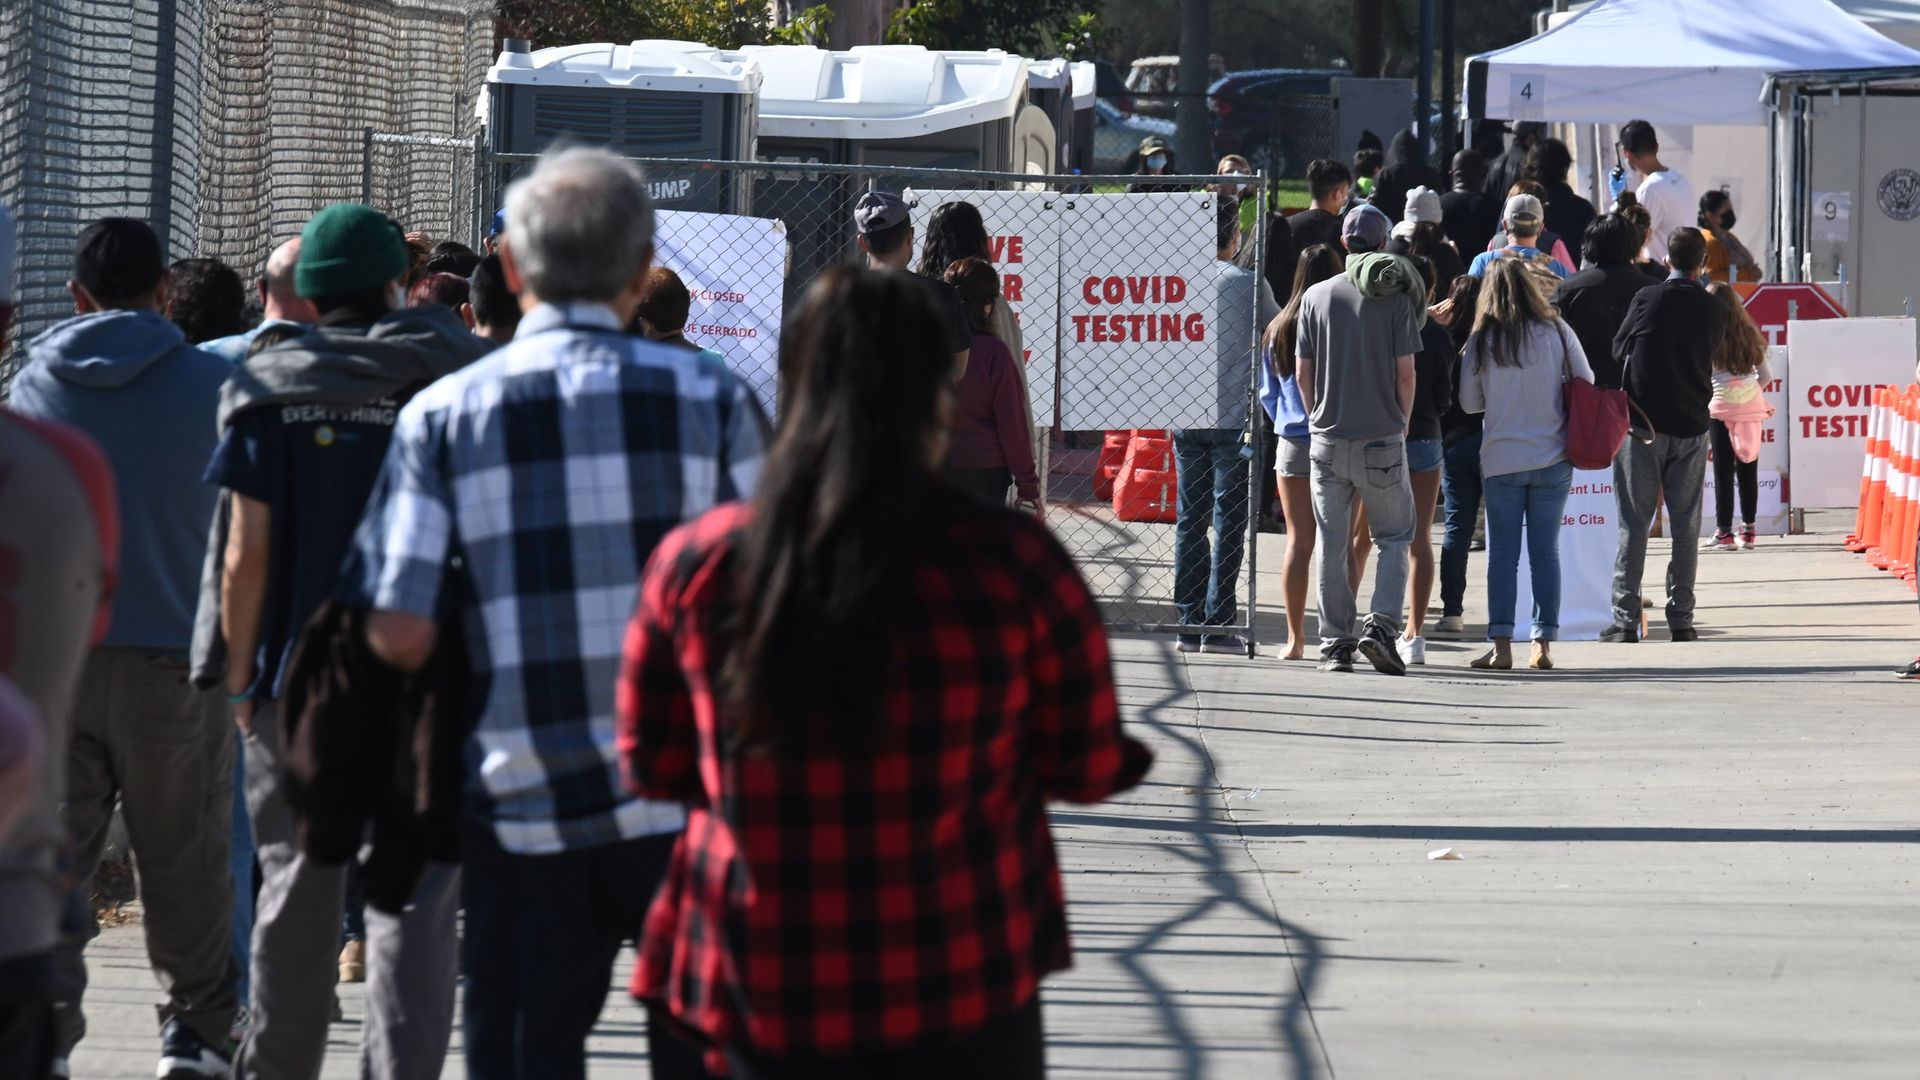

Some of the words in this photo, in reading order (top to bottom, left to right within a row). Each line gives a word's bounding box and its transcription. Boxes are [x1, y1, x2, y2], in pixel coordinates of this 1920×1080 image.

[1520, 82, 1533, 100] 4
[643, 179, 691, 200] UMP
[1824, 201, 1837, 220] 9
[701, 290, 745, 303] CLOSED
[999, 274, 1023, 301] R
[1083, 276, 1186, 305] COVID
[1072, 312, 1205, 343] TESTING
[1807, 384, 1887, 408] COVI
[1798, 415, 1868, 438] TESTI
[1592, 484, 1613, 494] Lin
[1579, 514, 1605, 525] Cita
